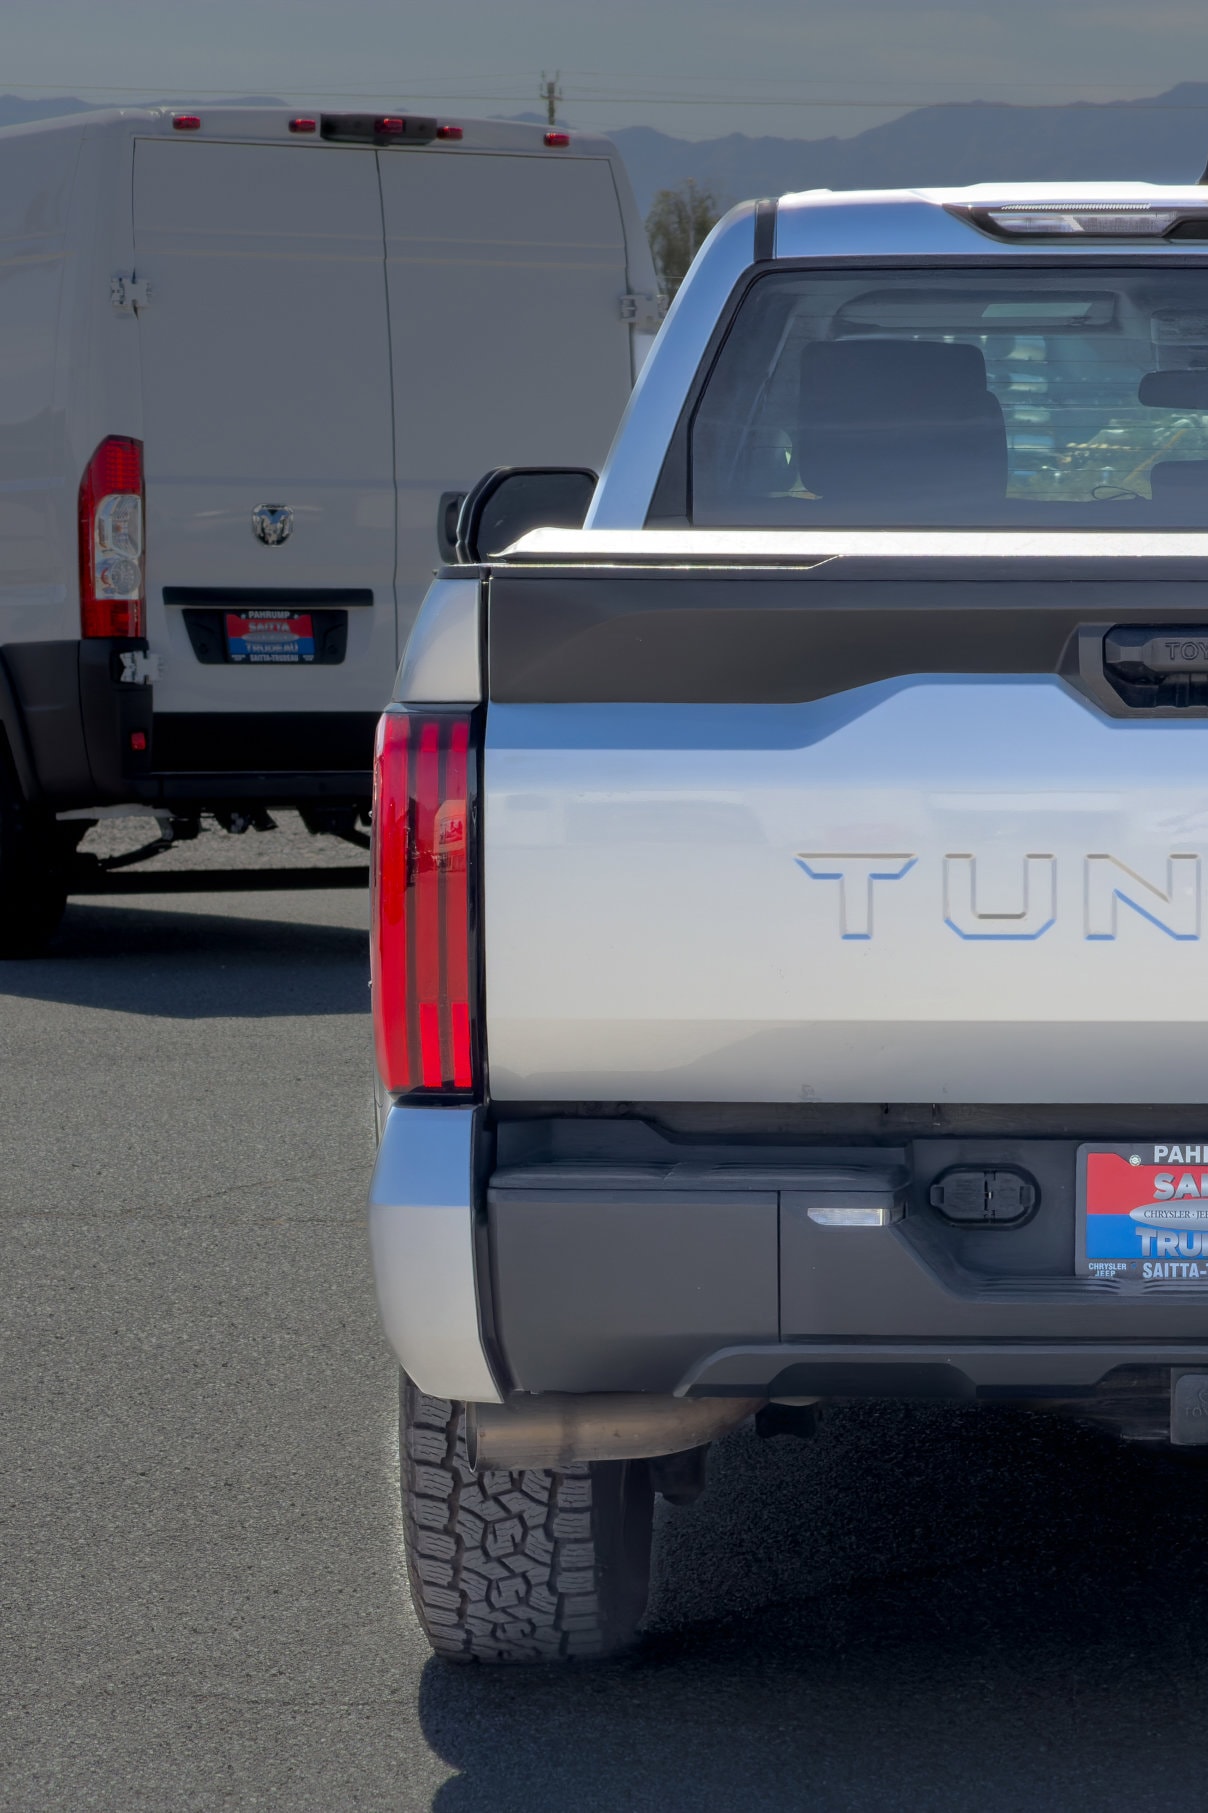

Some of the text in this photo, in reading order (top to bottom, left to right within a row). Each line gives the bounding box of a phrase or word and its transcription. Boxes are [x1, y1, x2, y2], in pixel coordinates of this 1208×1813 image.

[249, 623, 291, 632] SAITTA
[246, 642, 299, 653] TRUDEAU
[1143, 1209, 1191, 1220] CHRYSLER
[1088, 1262, 1127, 1271] CHRYSLER
[1094, 1269, 1116, 1278] JEEP
